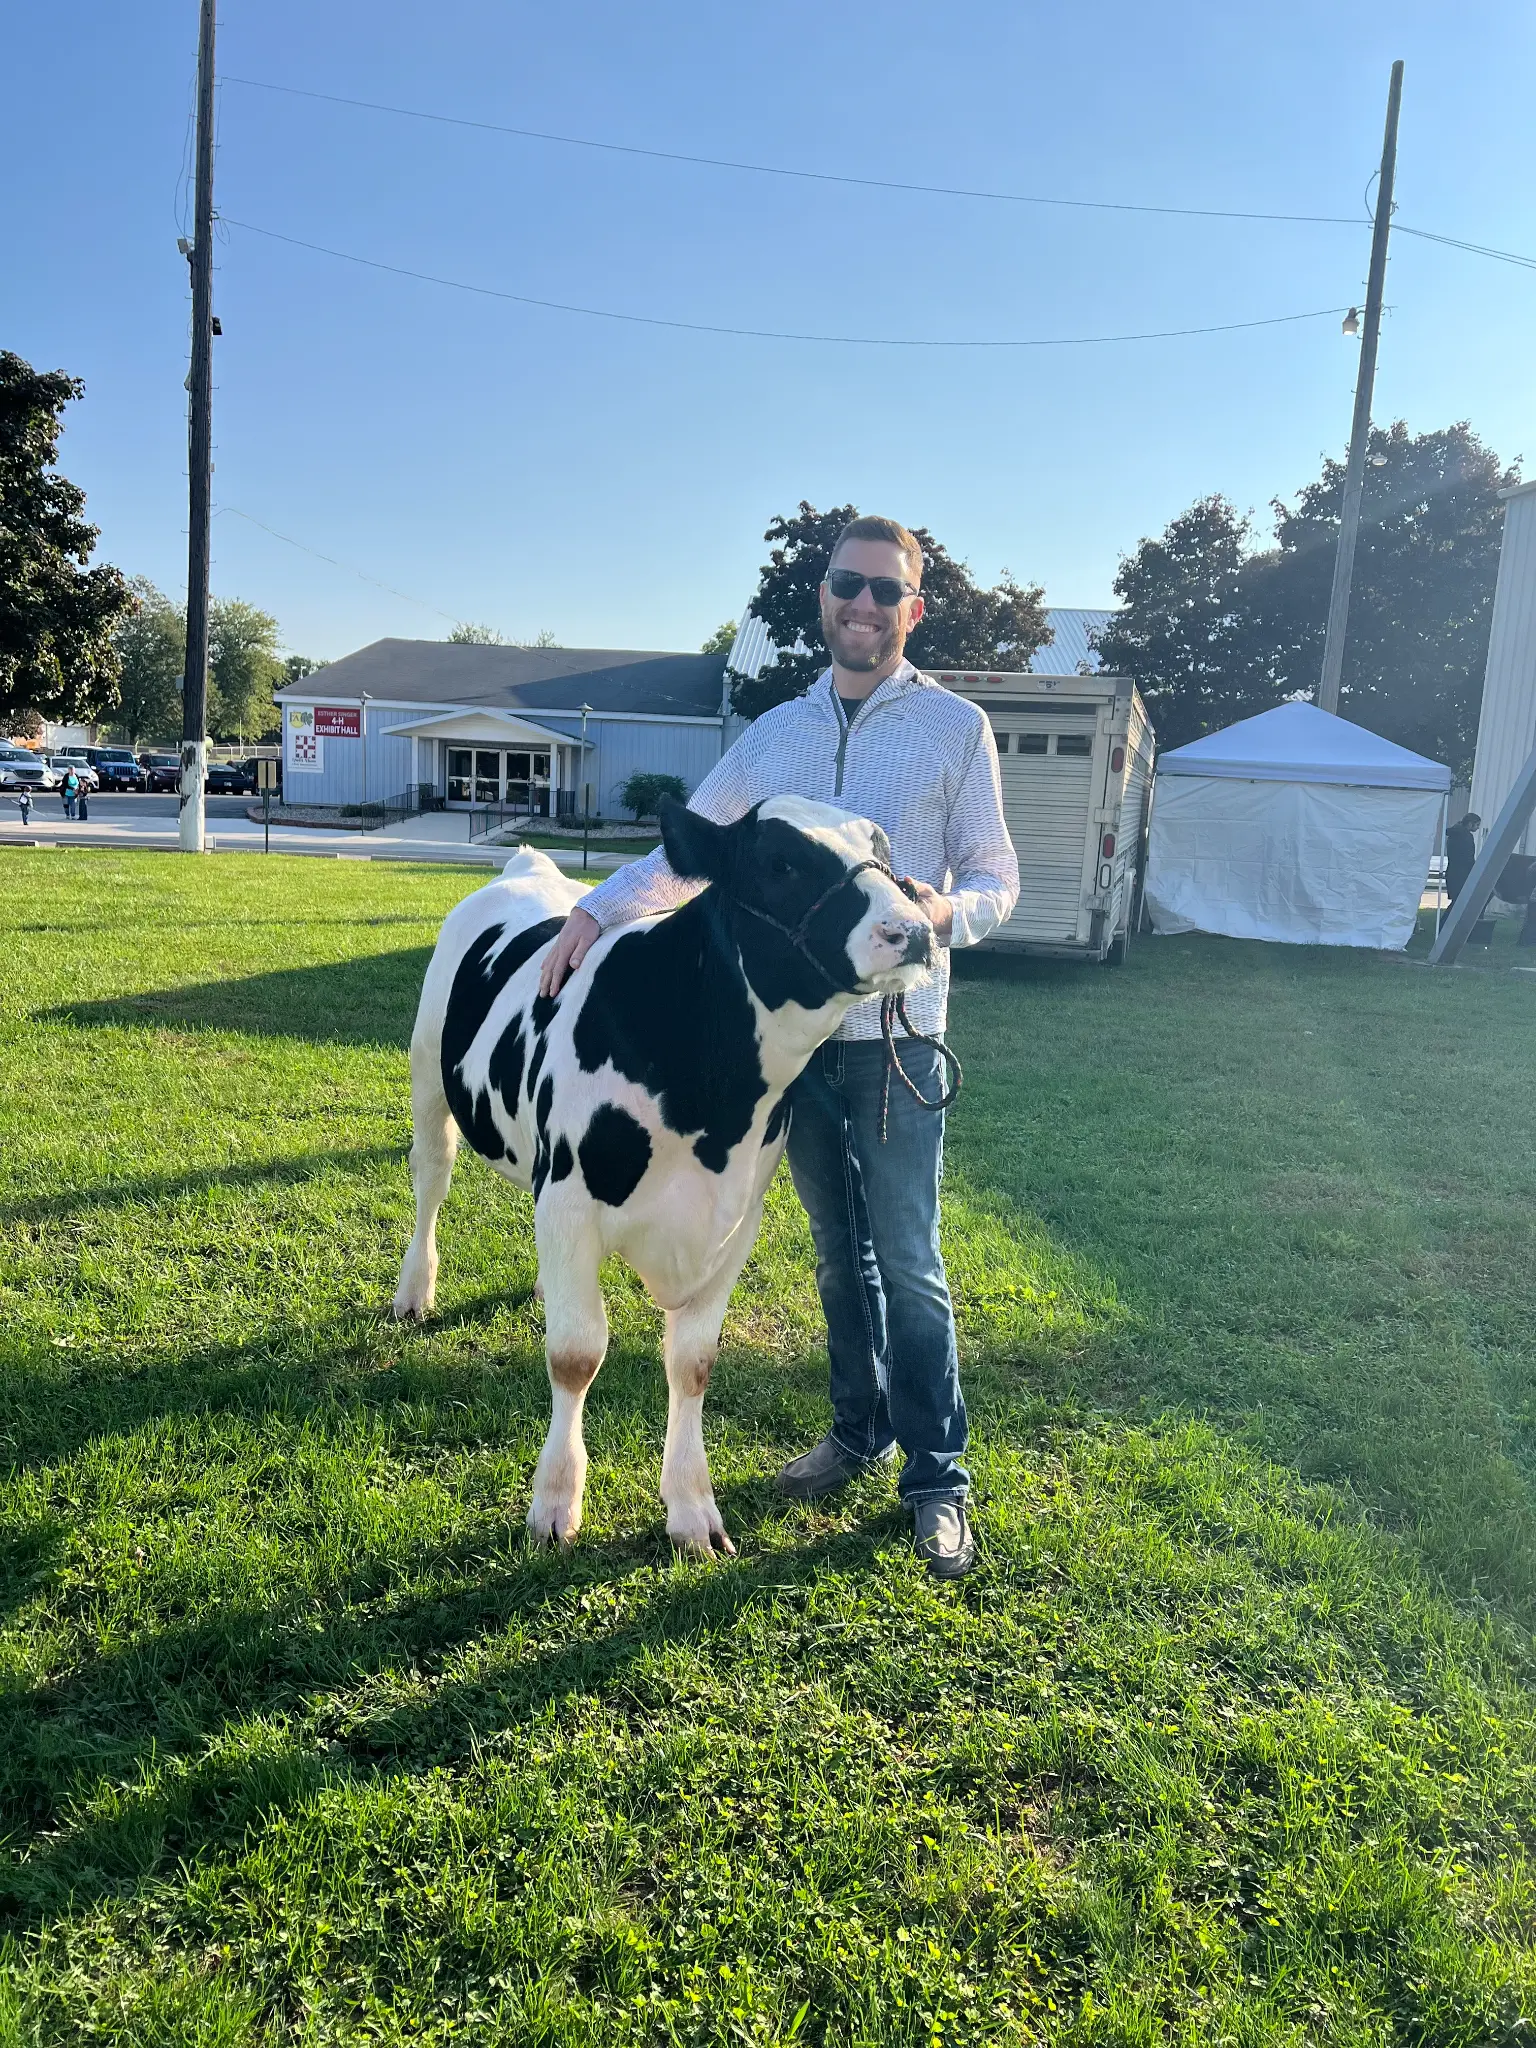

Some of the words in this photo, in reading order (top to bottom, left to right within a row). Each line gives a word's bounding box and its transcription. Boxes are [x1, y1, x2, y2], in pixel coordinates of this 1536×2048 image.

[332, 717, 344, 725] 4-H
[316, 725, 340, 733] EXHIBIT
[341, 726, 358, 734] HALL
